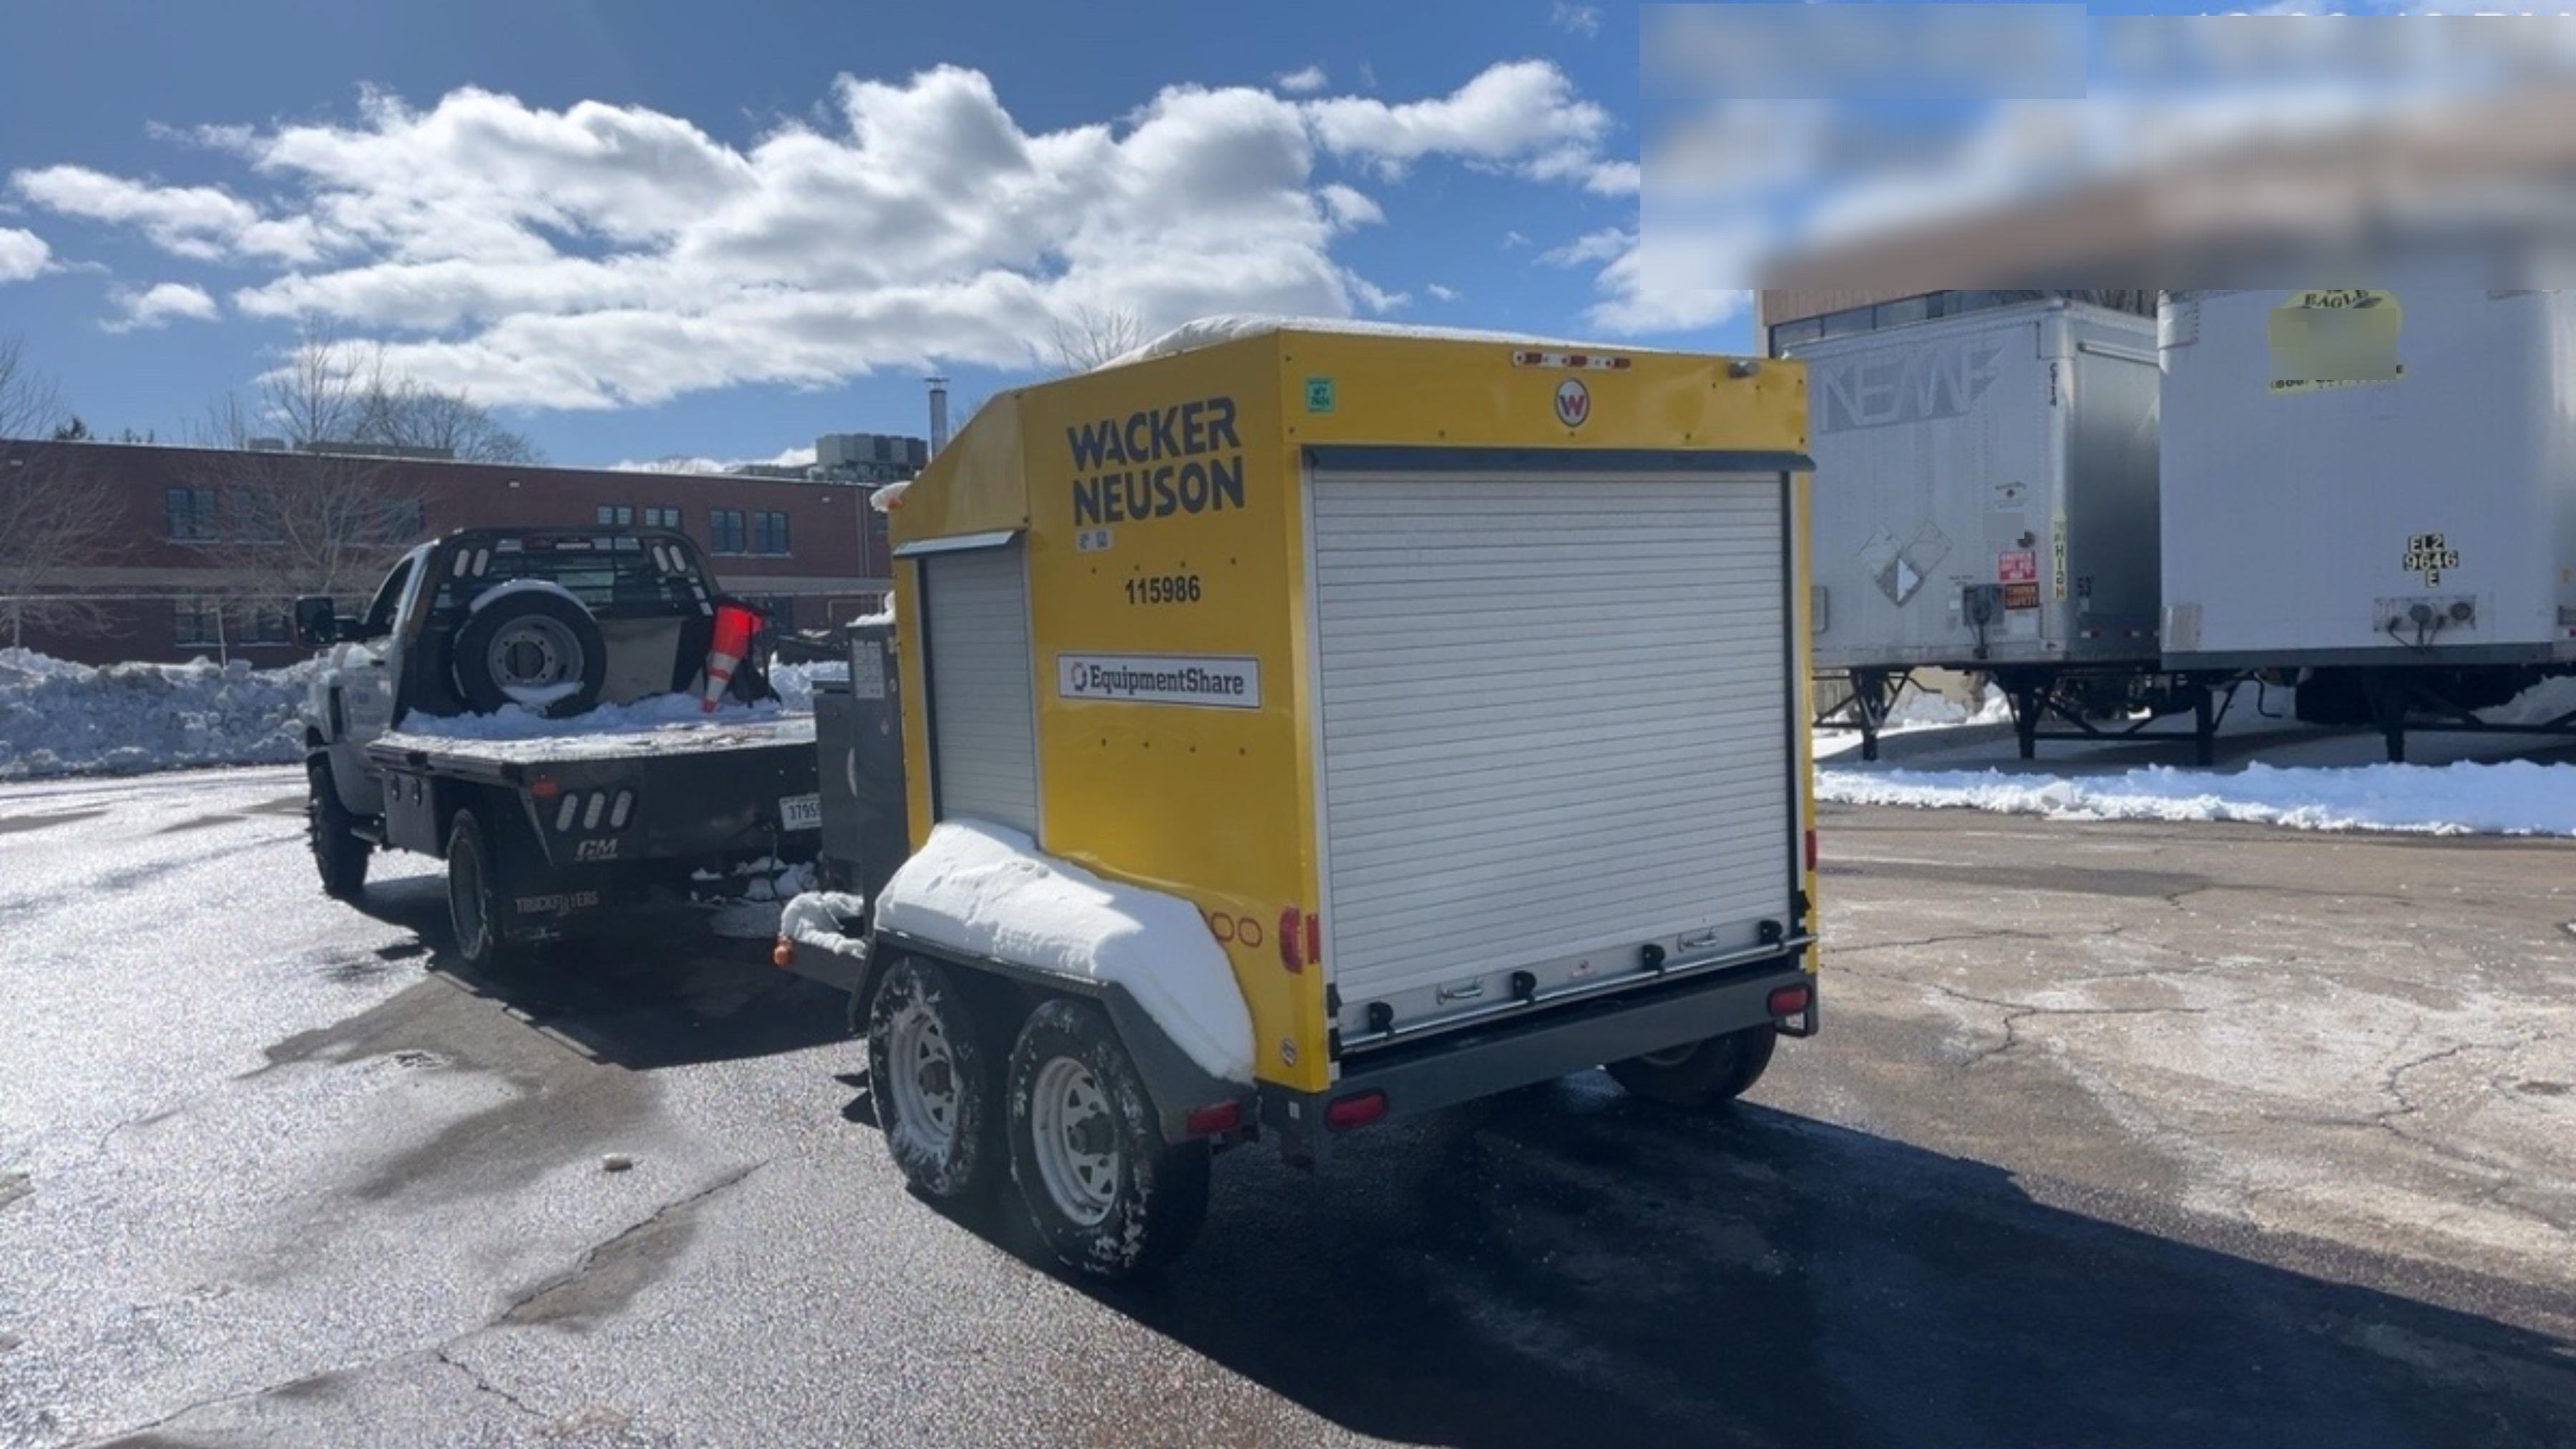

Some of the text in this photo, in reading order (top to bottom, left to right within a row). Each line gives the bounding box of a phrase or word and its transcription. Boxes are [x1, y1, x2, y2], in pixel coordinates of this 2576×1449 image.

[1066, 396, 1241, 472] WACKER
[1073, 456, 1244, 527] NEUSON
[2405, 550, 2458, 570] 9646
[1125, 575, 1201, 604] 115986
[2426, 569, 2439, 587] E
[1090, 665, 1244, 695] EquipmentShare
